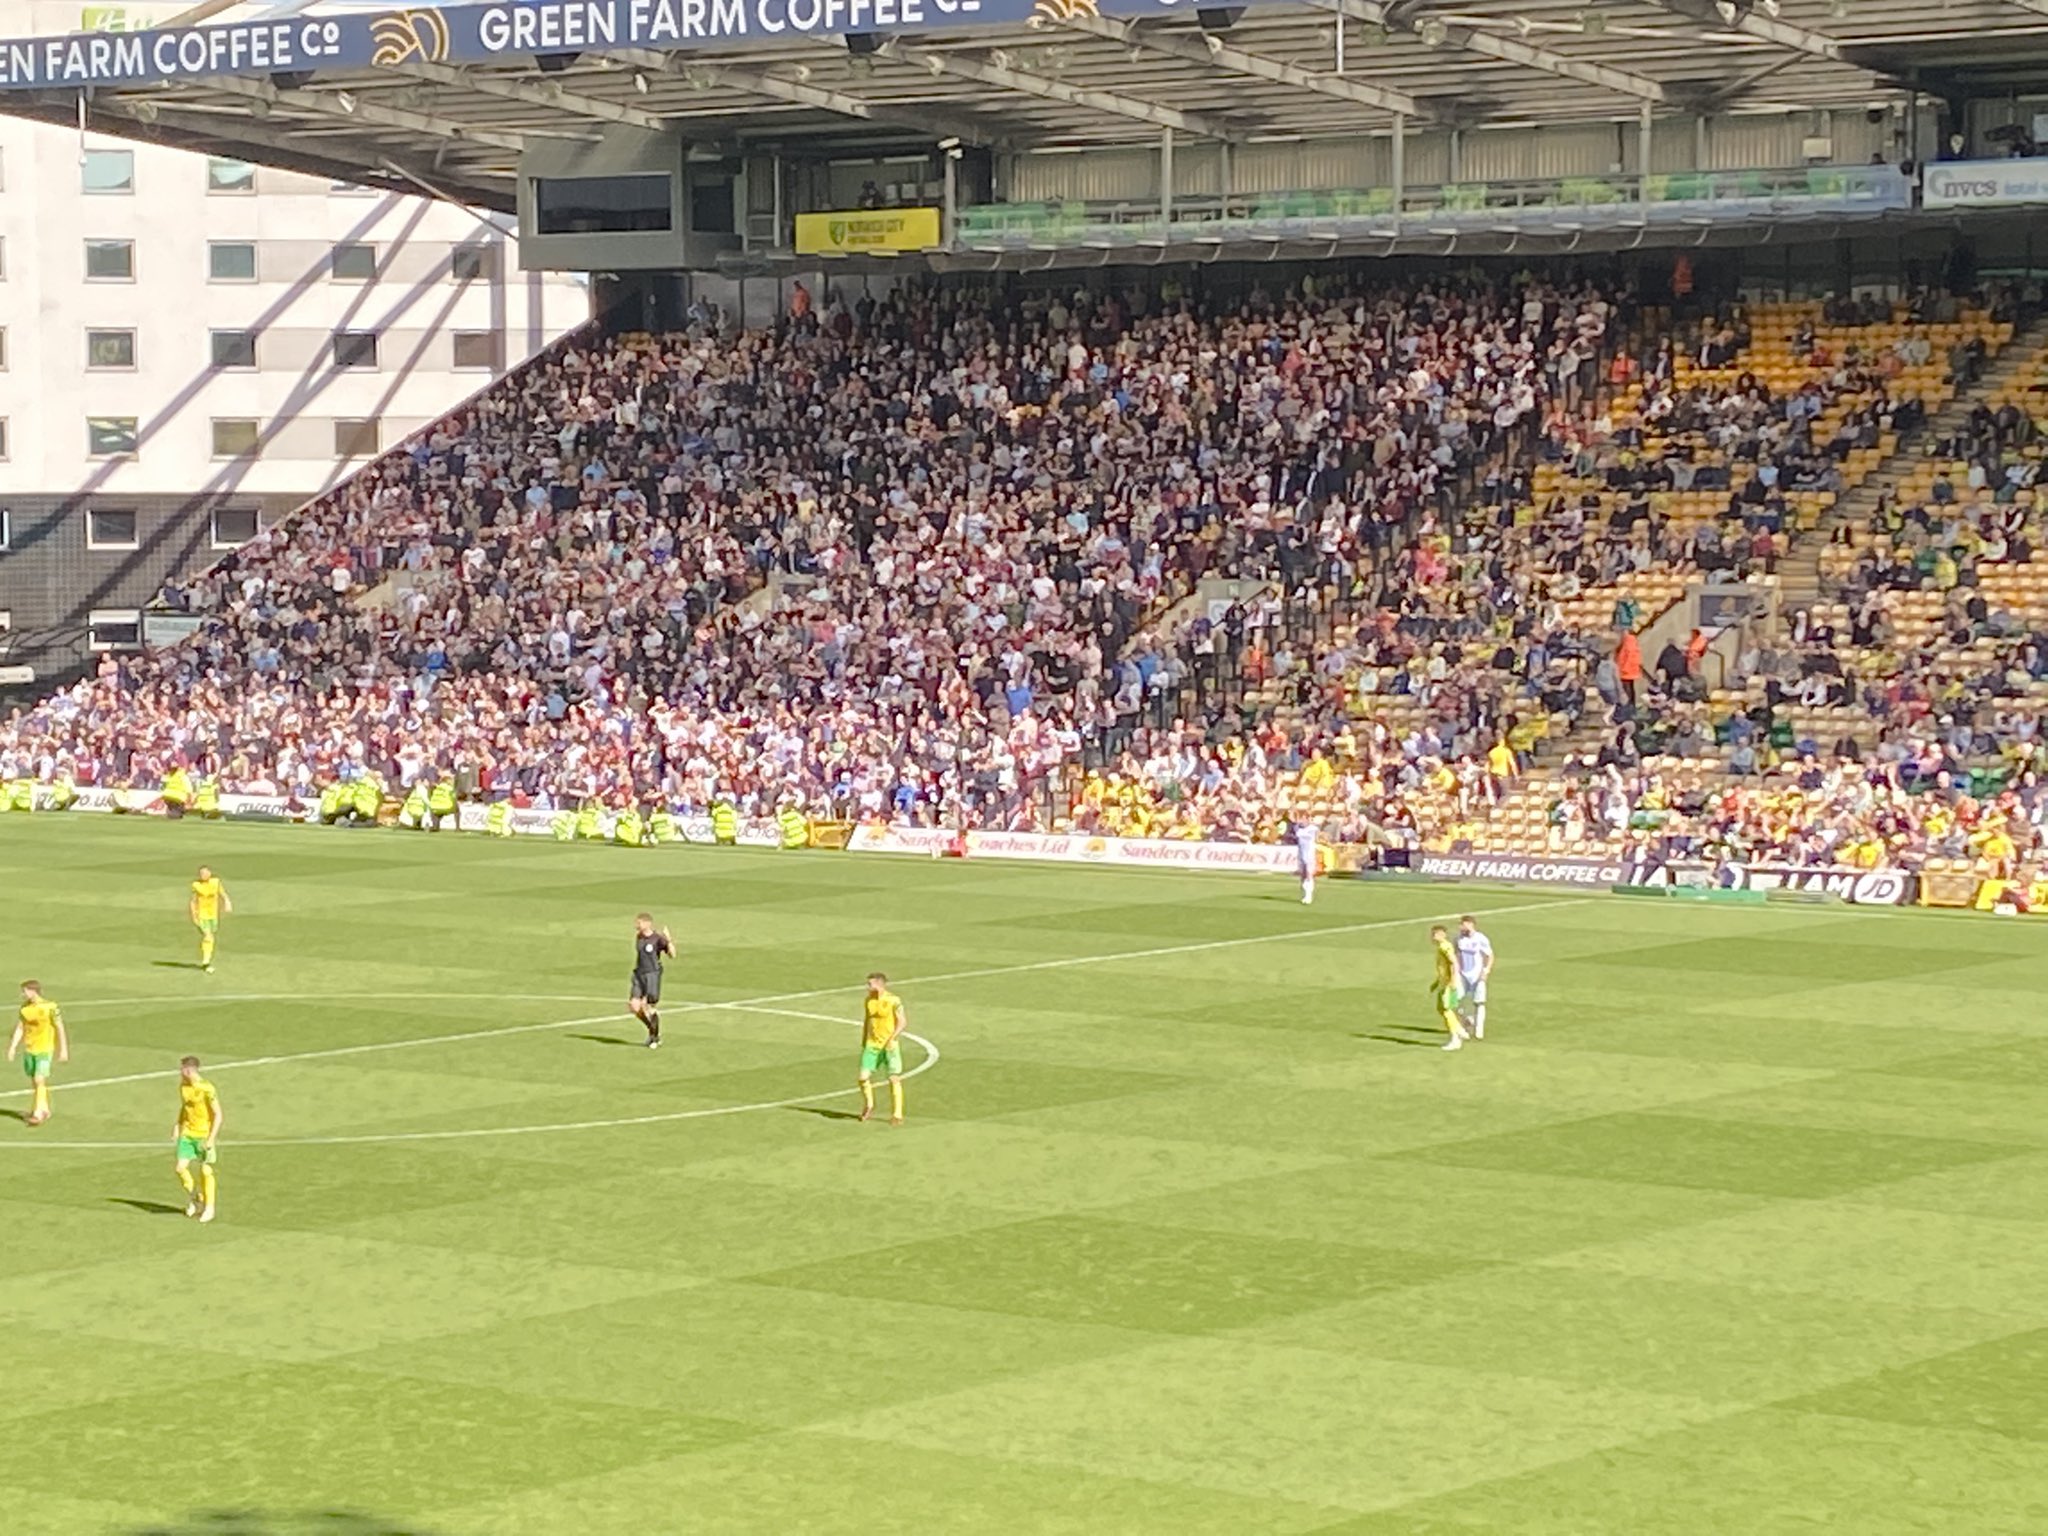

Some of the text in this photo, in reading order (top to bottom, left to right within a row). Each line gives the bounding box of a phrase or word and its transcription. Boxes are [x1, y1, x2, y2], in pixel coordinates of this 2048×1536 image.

[479, 0, 923, 51] GREEN FARM COFFEE
[46, 37, 145, 81] FARM
[153, 25, 293, 74] COFFEE
[1118, 841, 1298, 867] Sanders Coaches Lt
[1475, 860, 1527, 879] FARM
[1528, 863, 1598, 883] COFFEE
[1862, 879, 1897, 899] JD
